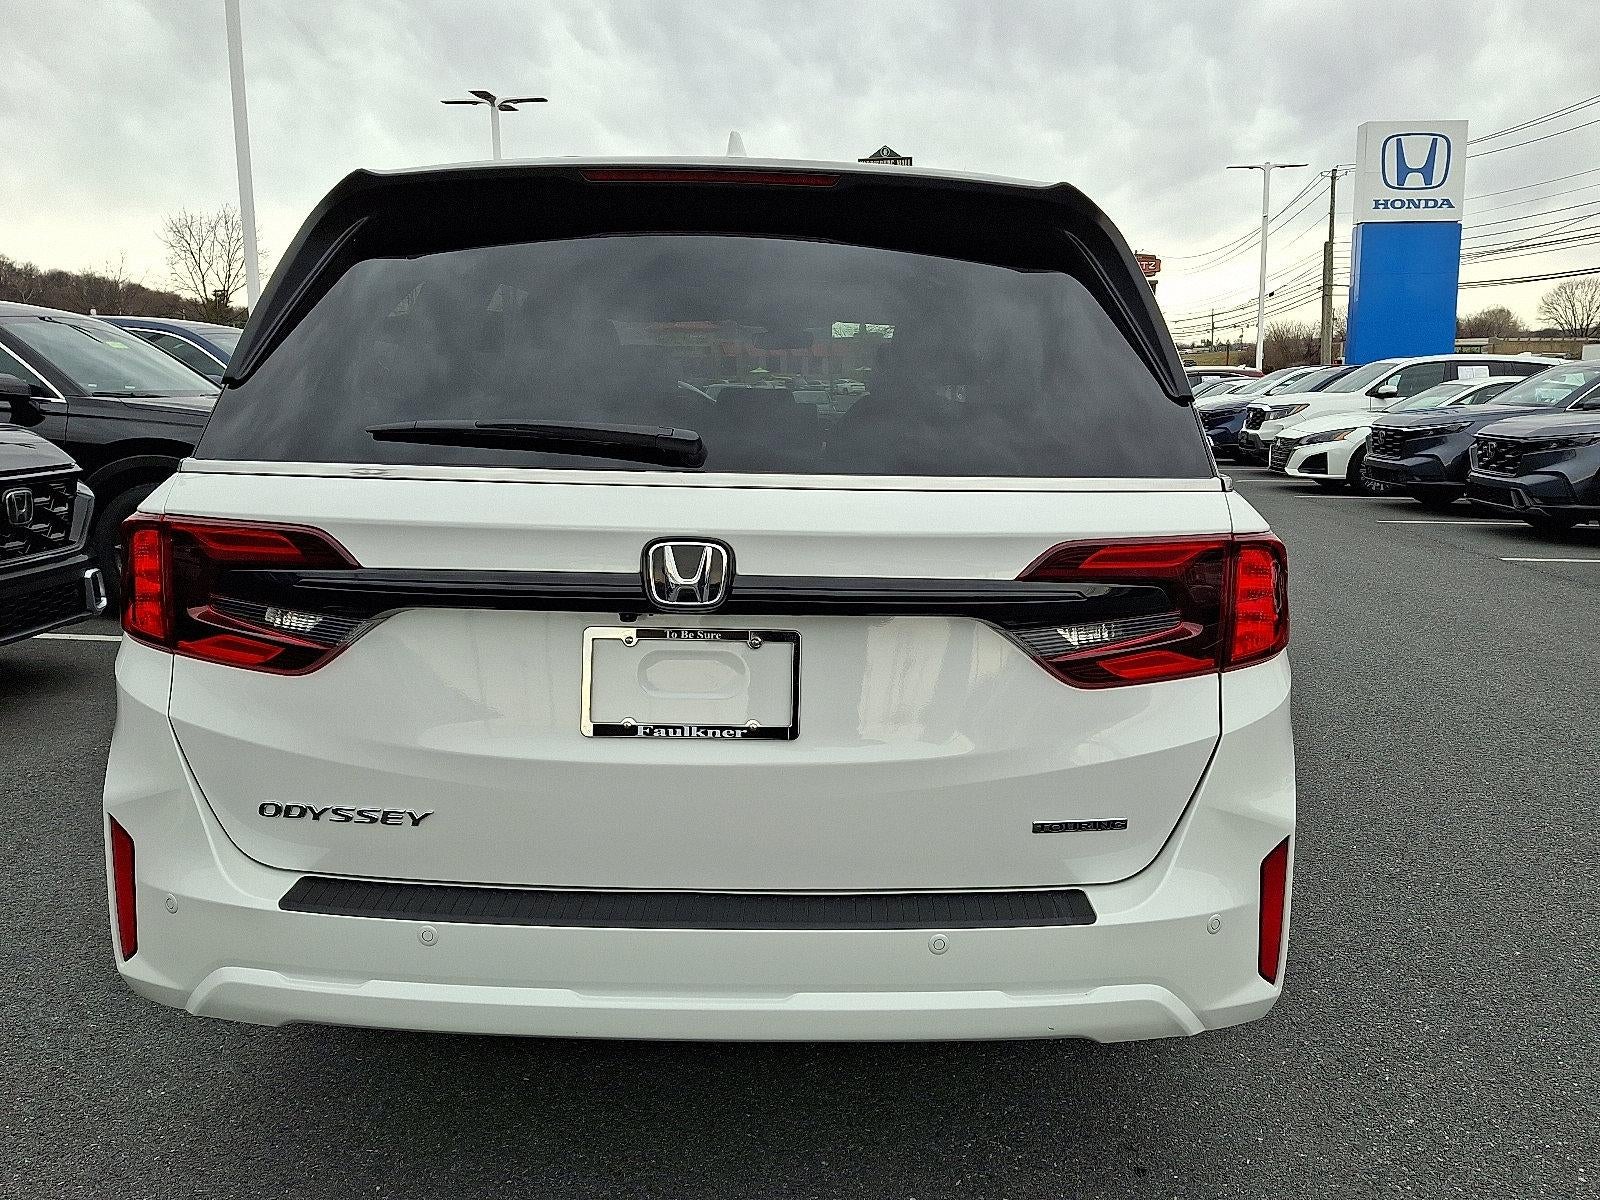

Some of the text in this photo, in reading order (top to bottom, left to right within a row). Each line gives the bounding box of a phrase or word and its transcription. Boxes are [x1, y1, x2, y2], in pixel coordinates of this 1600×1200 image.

[1372, 198, 1455, 210] HONDA
[1139, 261, 1156, 270] TZ
[664, 629, 722, 640] To Be Sure
[636, 725, 748, 738] Faulkner
[258, 801, 434, 827] ODYSSEY
[1032, 819, 1127, 833] TOURING
